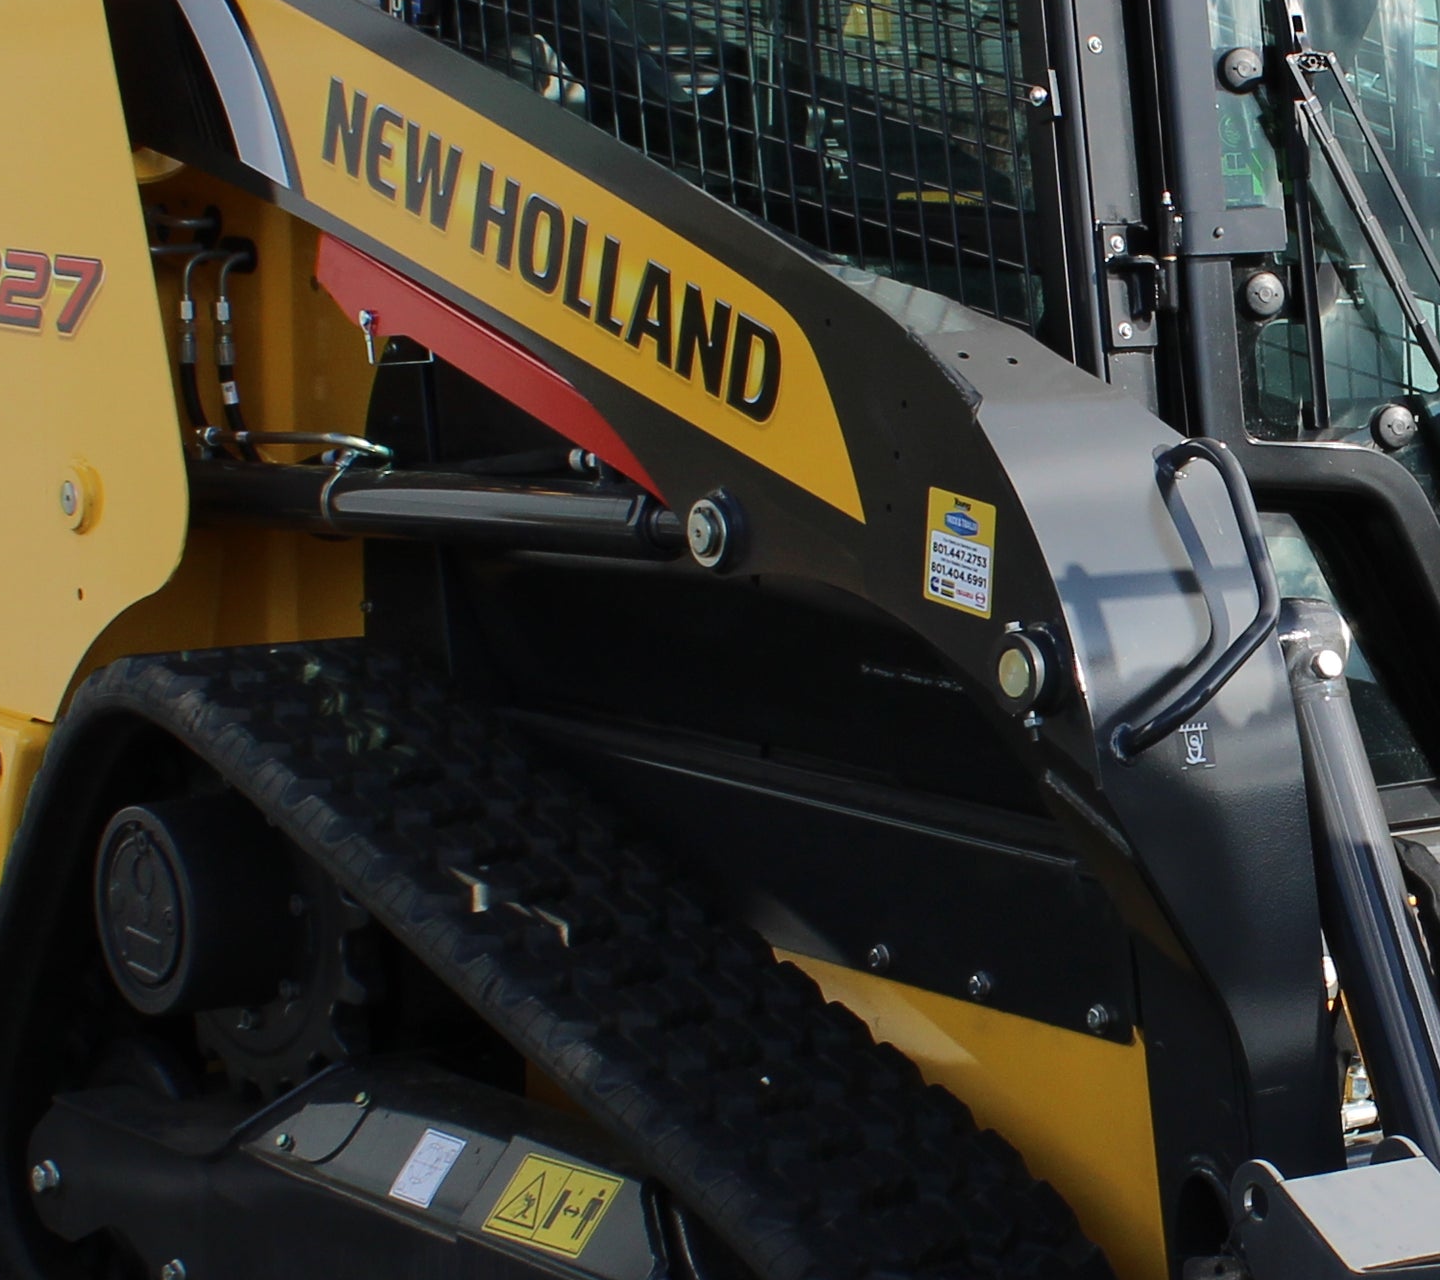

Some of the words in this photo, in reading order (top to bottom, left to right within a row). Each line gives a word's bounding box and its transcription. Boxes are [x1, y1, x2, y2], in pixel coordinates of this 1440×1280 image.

[321, 75, 462, 232] NEW
[471, 161, 782, 423] HOLLAND
[933, 542, 987, 568] 801.447.2753
[931, 562, 987, 588] 801.404.6991
